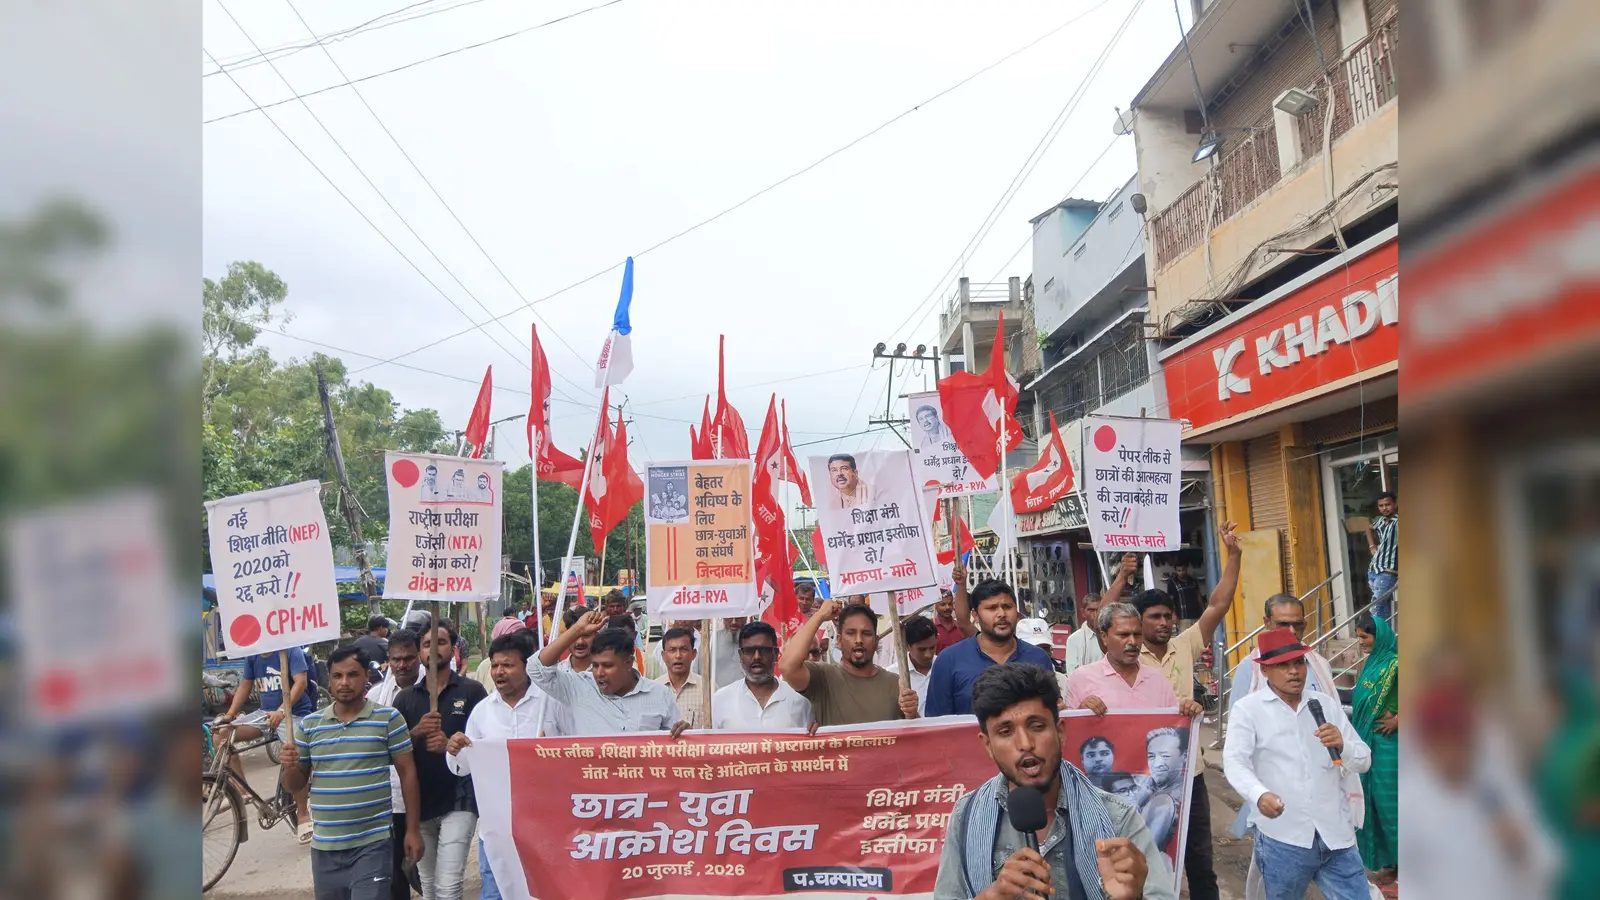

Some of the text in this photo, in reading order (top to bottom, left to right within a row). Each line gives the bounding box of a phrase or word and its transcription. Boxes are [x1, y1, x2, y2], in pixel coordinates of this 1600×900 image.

[1118, 444, 1172, 464] पेपर लीक से
[695, 473, 723, 490] बेहतर
[1096, 466, 1172, 485] छात्रों की आत्महत्या
[695, 490, 742, 508] भविष्य के
[1097, 486, 1168, 507] की जवाबदेही तय
[227, 508, 248, 530] नई
[408, 508, 478, 530] राष्ट्रीय परीक्षा
[695, 511, 715, 526] लिए
[851, 503, 900, 524] शिक्षा मंत्री
[227, 522, 320, 552] शिक्षा नीति (NEP)
[416, 532, 482, 551] एजेंसी (NTA)
[695, 525, 746, 544] छात्र-युवाओं
[857, 530, 884, 546] प्रधान
[886, 523, 920, 542] इस्तीफा
[696, 542, 734, 558] का संघर्ष
[412, 553, 426, 568] को
[428, 555, 448, 570] भंग
[408, 572, 472, 592] aisa-RYA
[236, 585, 254, 603] रद्द
[672, 587, 728, 604] aisa-RYA
[266, 603, 328, 636] CPI-ML
[535, 744, 562, 758] पेपर
[563, 743, 594, 759] लीक
[640, 740, 664, 758] और
[666, 740, 706, 758] परीक्षा
[708, 742, 758, 756] व्यवस्था
[761, 739, 772, 754] में
[774, 740, 826, 754] भ्रष्टाचार
[828, 737, 842, 748] के
[845, 736, 897, 748] खिलाफ
[582, 764, 609, 780] जंतर
[649, 766, 666, 778] पर
[672, 766, 695, 779] चल
[698, 764, 714, 780] रहे
[717, 761, 770, 778] आंदोलन
[773, 758, 788, 772] के
[791, 756, 834, 772] समर्थन
[837, 754, 848, 771] में
[678, 789, 754, 827] युवा
[866, 788, 920, 808] शिक्षा
[914, 813, 950, 829] प्रधा
[570, 818, 820, 861] आक्रोश दिवस
[860, 833, 936, 855] इस्तीफा
[622, 867, 643, 880] 20
[704, 864, 745, 877] 2026
